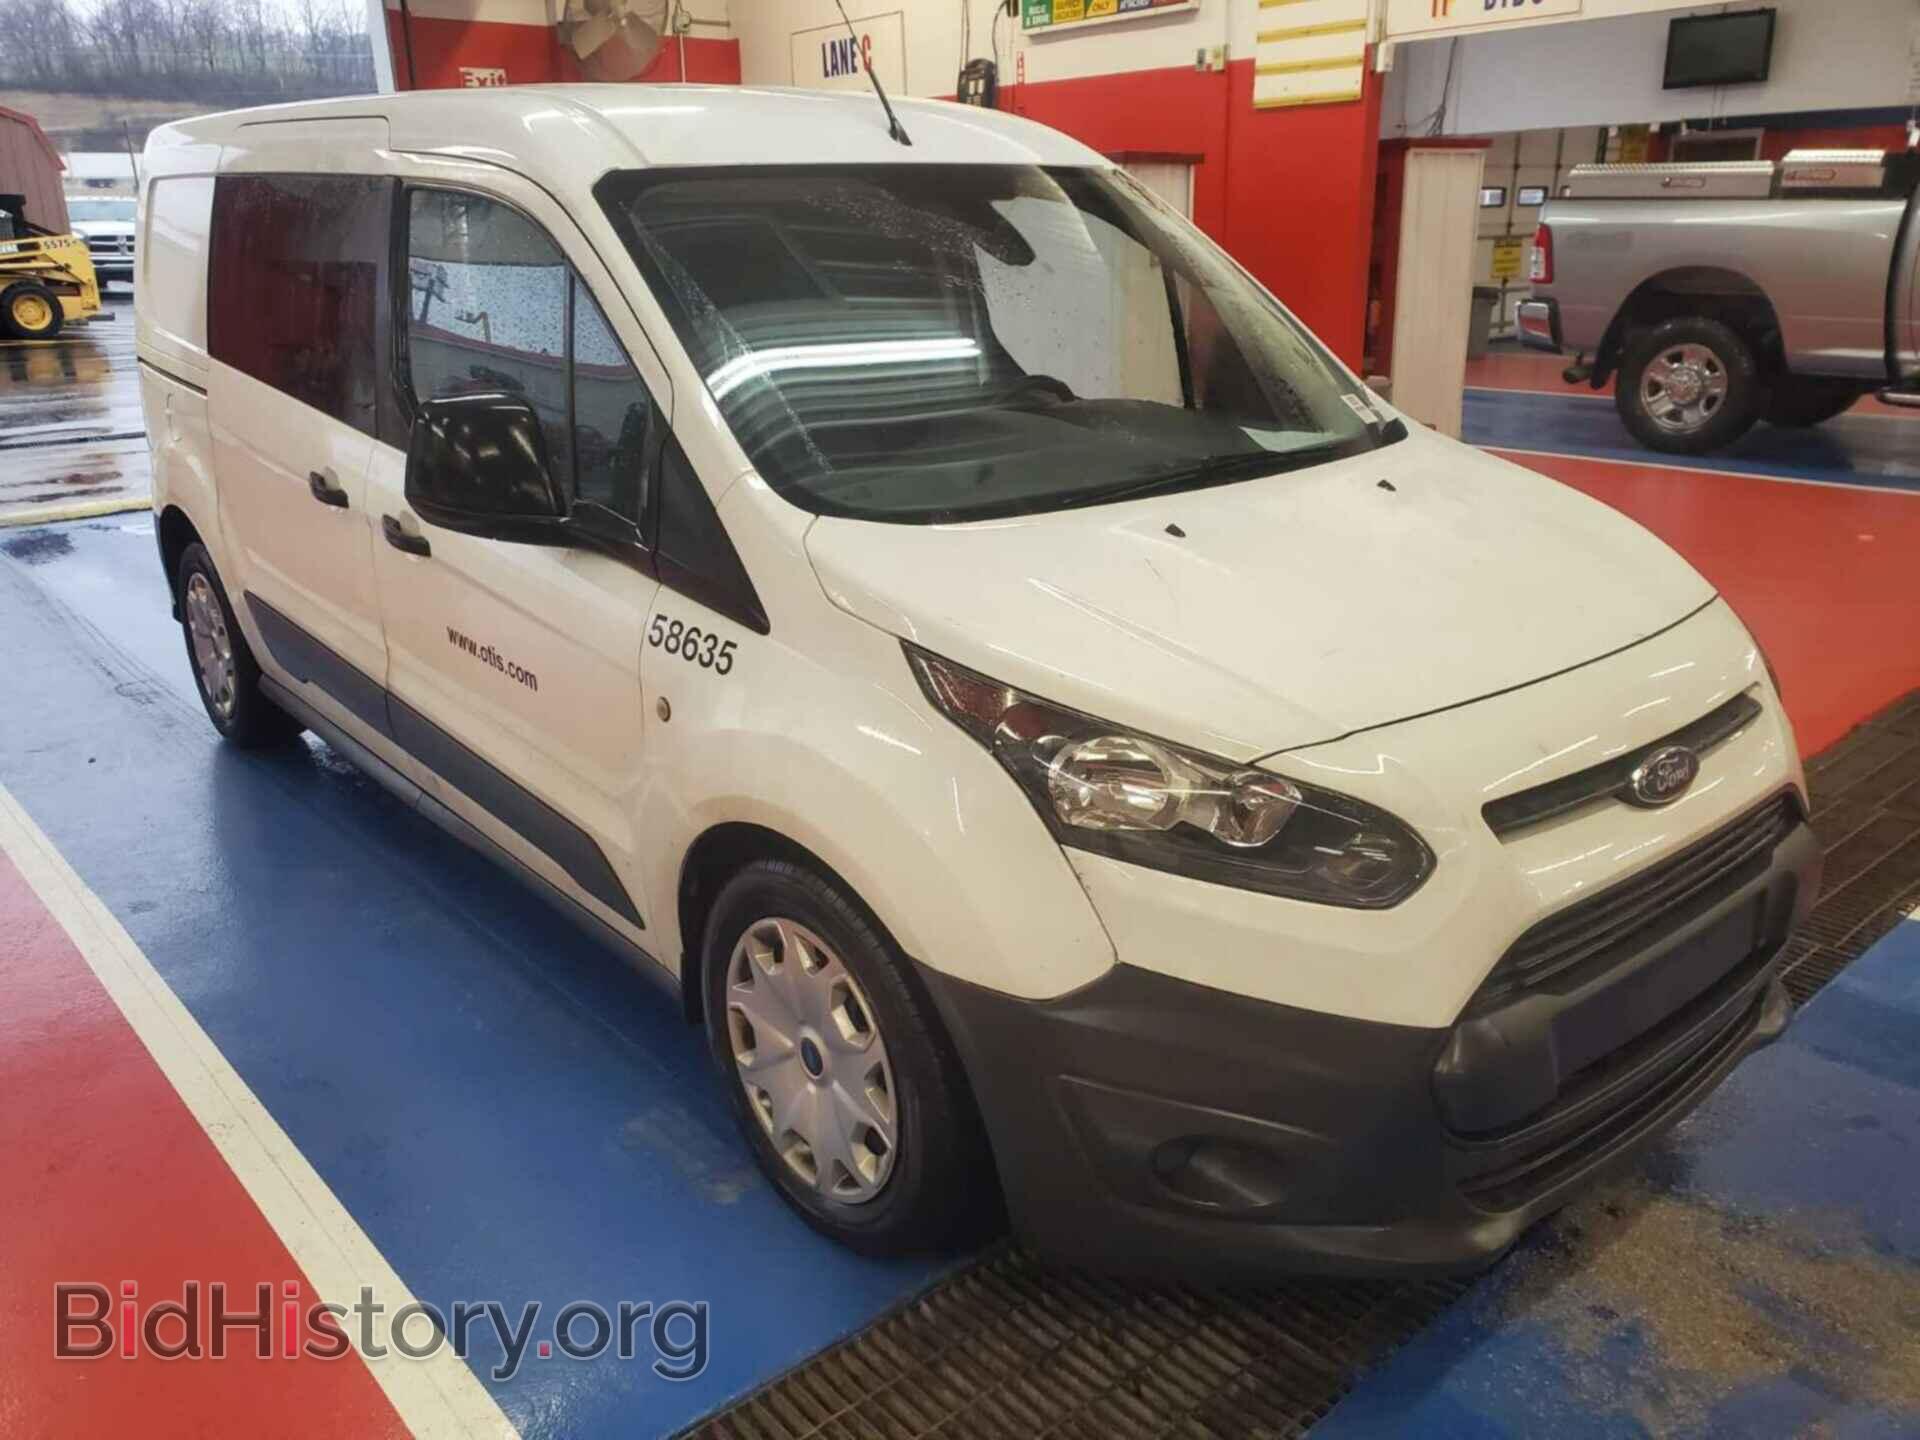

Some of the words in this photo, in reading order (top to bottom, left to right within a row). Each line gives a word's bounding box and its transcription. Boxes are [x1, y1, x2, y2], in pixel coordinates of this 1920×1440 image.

[822, 37, 858, 78] LANE
[862, 33, 872, 74] C
[462, 70, 507, 88] Exit
[446, 626, 539, 692] www.otis.com
[648, 614, 738, 676] 58635
[1656, 754, 1691, 792] Ford
